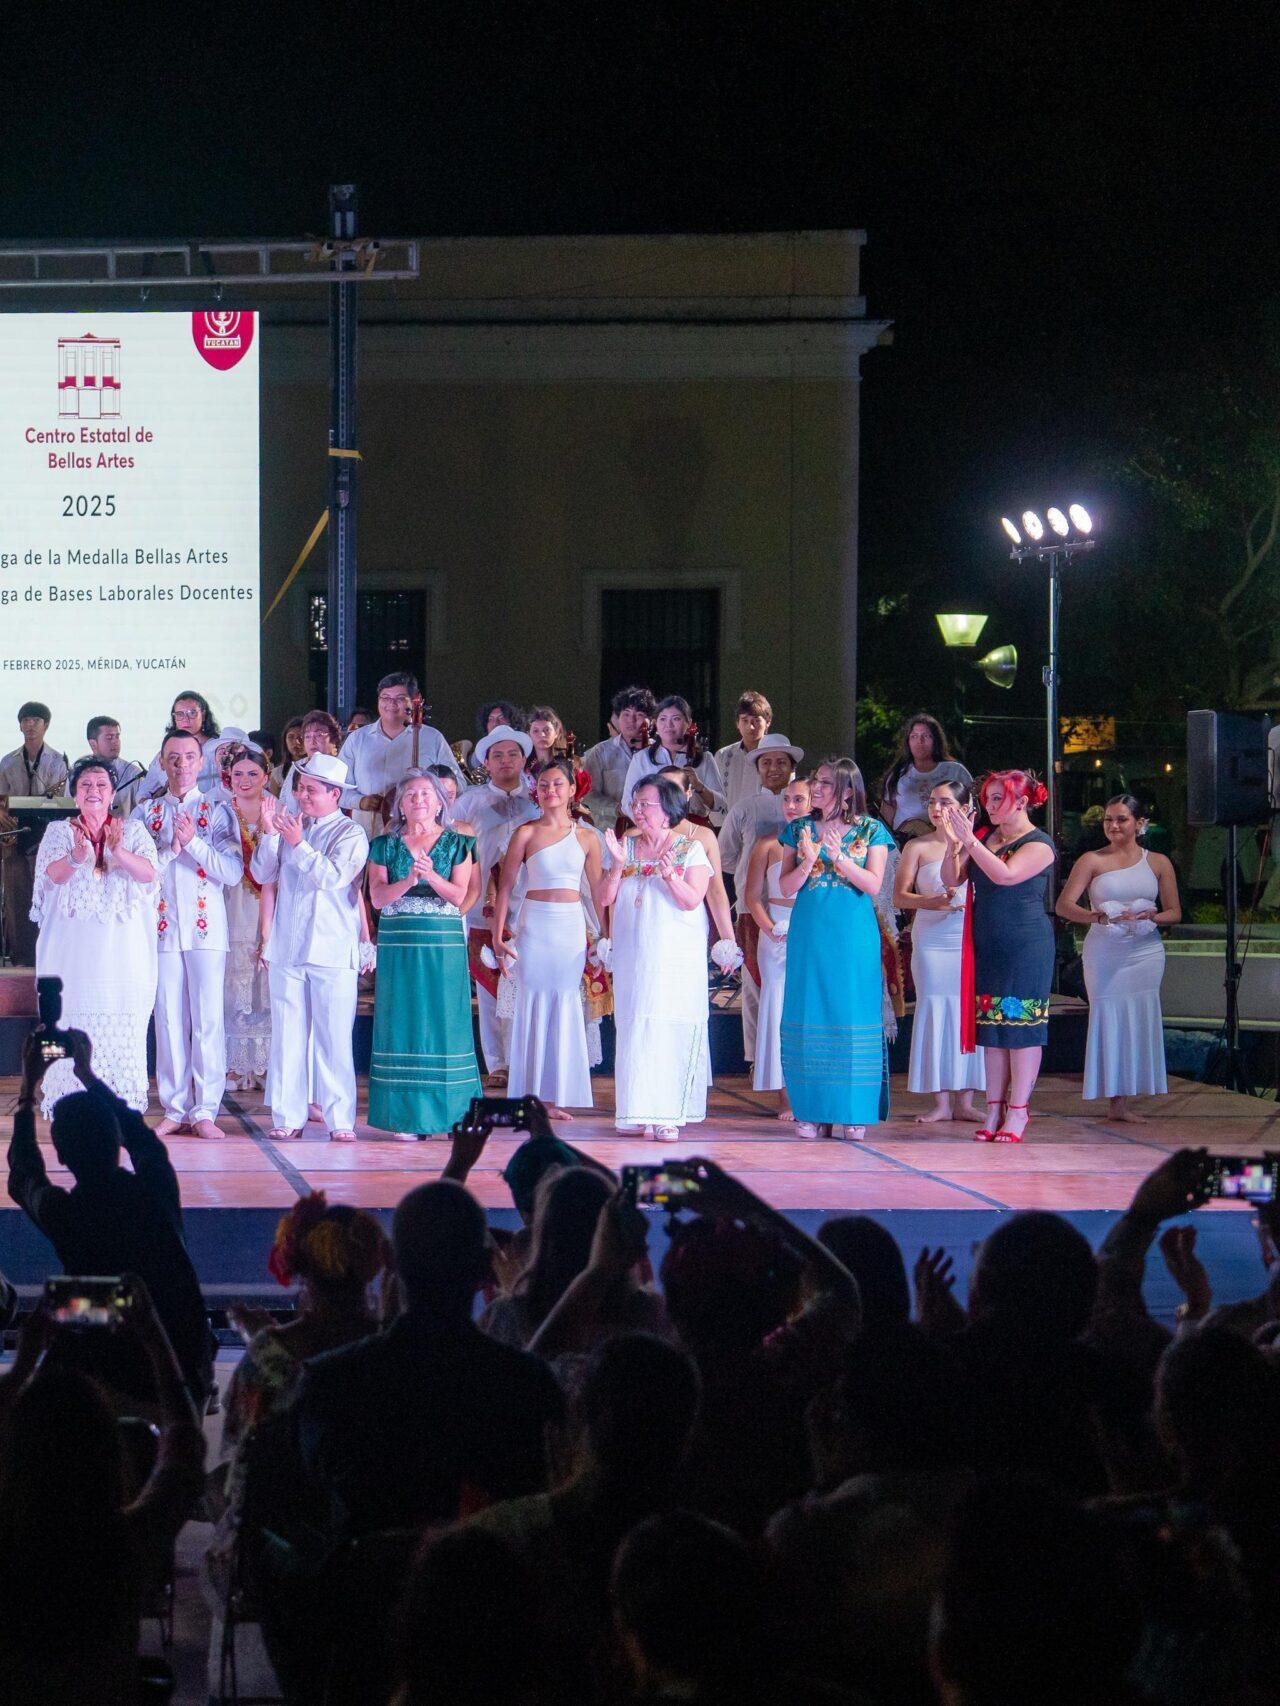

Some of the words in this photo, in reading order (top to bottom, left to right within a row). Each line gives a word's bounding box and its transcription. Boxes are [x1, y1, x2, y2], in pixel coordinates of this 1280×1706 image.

[25, 427, 75, 444] Centro
[80, 426, 131, 443] Estatal
[135, 426, 153, 443] de
[48, 452, 92, 468] Bellas
[96, 452, 135, 468] Artes
[62, 495, 116, 517] 2025
[24, 549, 41, 566] de
[48, 549, 61, 565] la
[67, 548, 129, 565] Medalla
[135, 548, 181, 565] Bellas
[186, 548, 229, 565] Artes
[24, 585, 42, 602] de
[49, 585, 93, 602] Bases
[99, 584, 174, 602] Laborales
[180, 584, 253, 600] Docentes
[3, 659, 52, 671] FEBRERO
[55, 659, 84, 672] 2025,
[87, 656, 132, 671] MÉRIDA,
[135, 655, 187, 670] YUCATÁN
